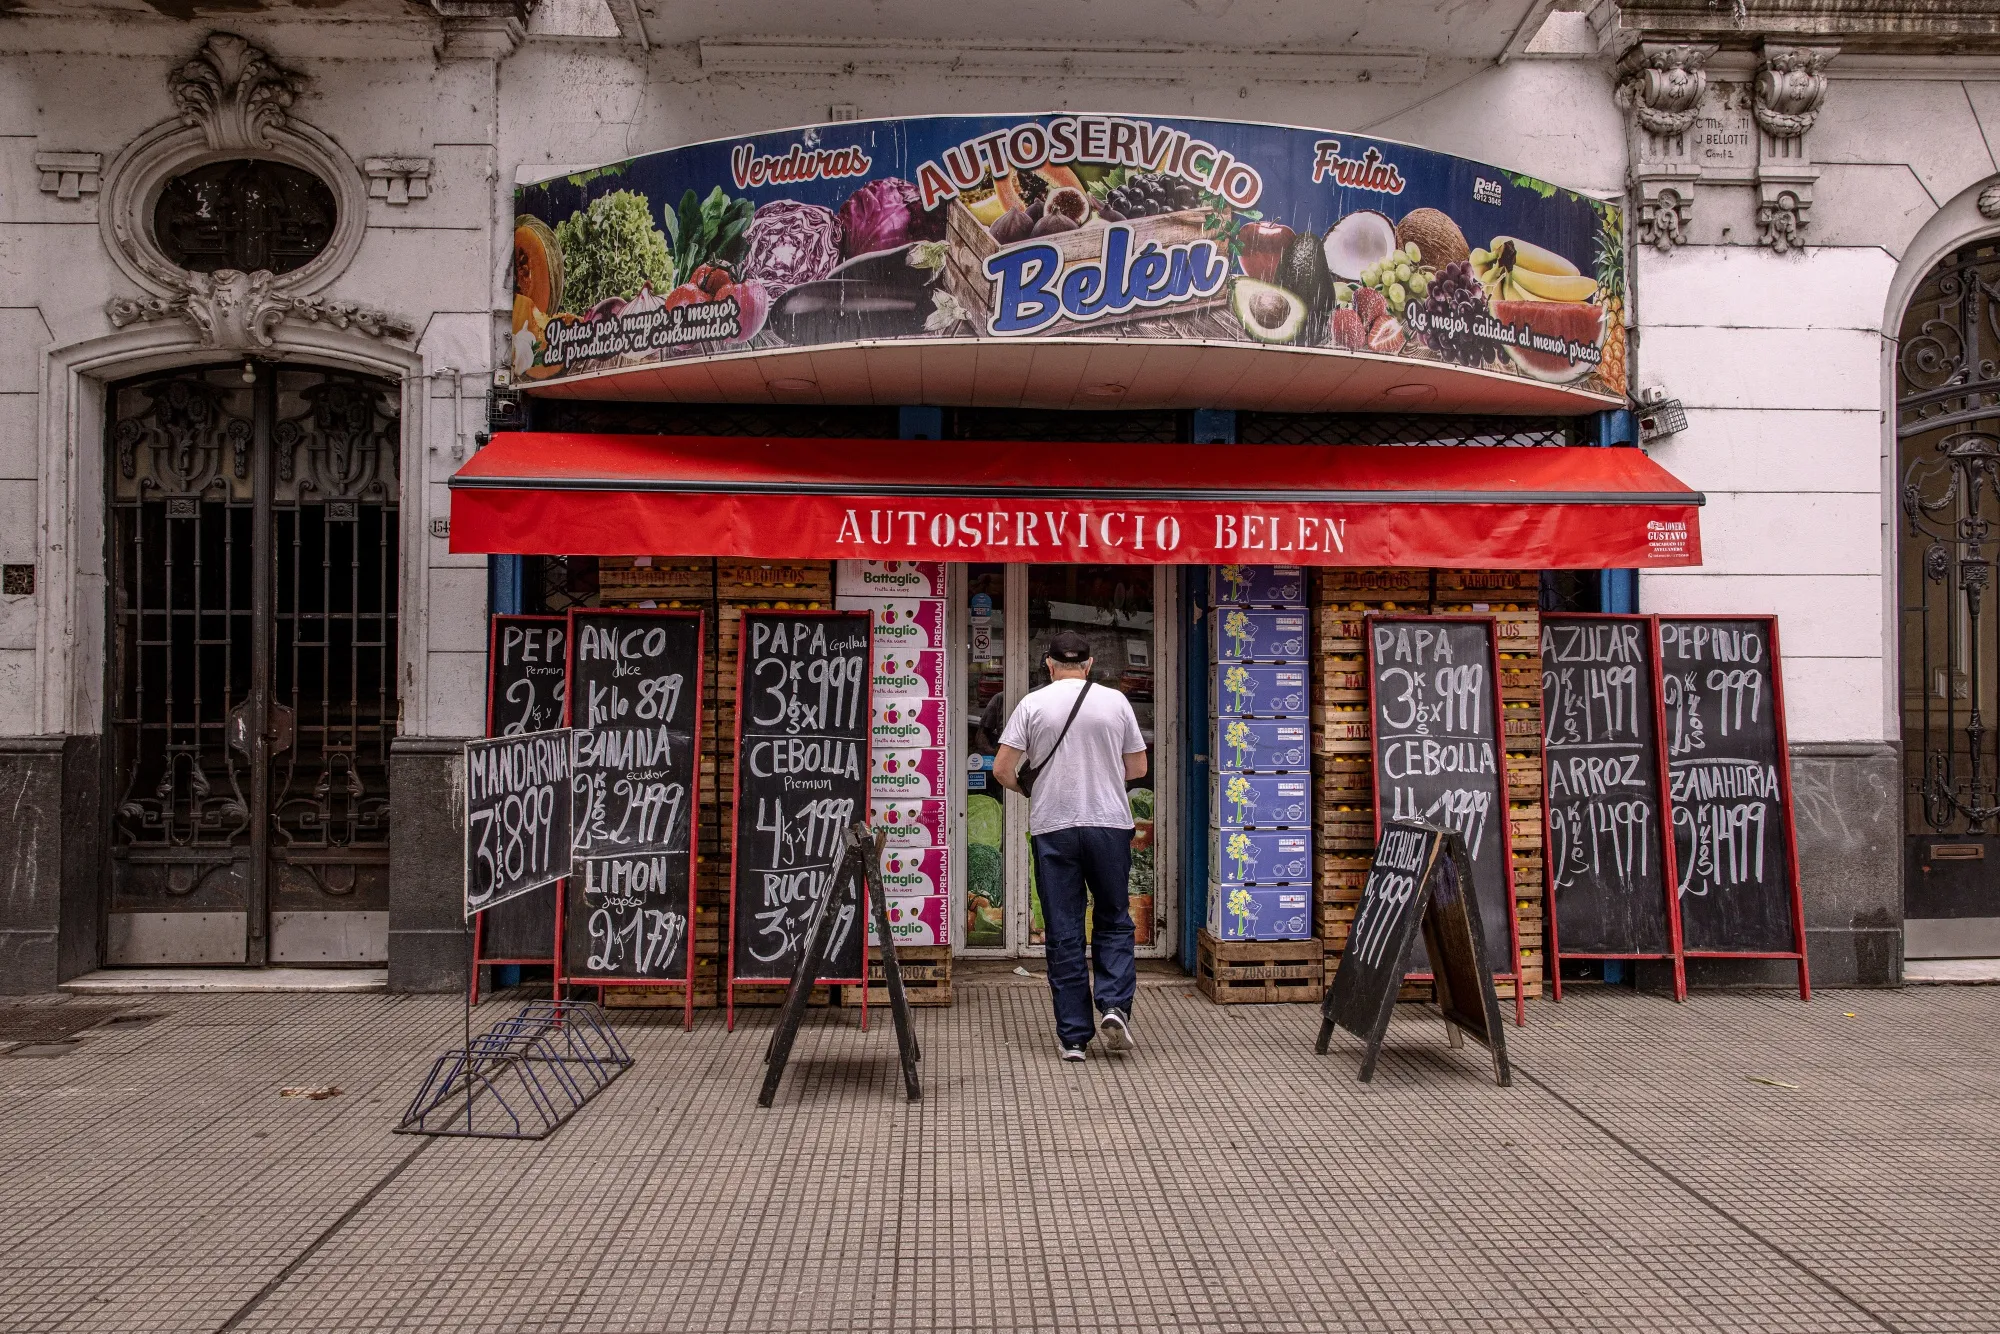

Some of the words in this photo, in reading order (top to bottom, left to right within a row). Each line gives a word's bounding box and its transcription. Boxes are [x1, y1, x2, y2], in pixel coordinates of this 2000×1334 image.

[1696, 134, 1703, 145] J
[1706, 132, 1748, 145] BELLOTTI
[732, 144, 870, 188] Verduras
[918, 117, 1261, 210] AUTOSERVICIO
[1312, 141, 1406, 194] Frutas
[1474, 177, 1502, 195] Rafa
[987, 227, 1228, 335] Belén
[544, 342, 563, 364] del
[566, 336, 630, 367] productor
[634, 329, 649, 348] al
[653, 318, 739, 346] consumidor
[547, 320, 592, 346] Ventas
[596, 321, 619, 343] por
[623, 312, 669, 337] mayor
[673, 309, 683, 331] y
[688, 299, 738, 321] menor
[1407, 301, 1428, 332] La
[1432, 313, 1469, 341] mejor
[1473, 318, 1516, 344] calidad
[1519, 328, 1531, 346] al
[1533, 335, 1568, 355] menor
[1569, 343, 1600, 365] precio
[836, 508, 1181, 552] AUTOSERVICIO
[1214, 513, 1347, 554] BELEN
[1647, 531, 1688, 541] GUSTAVO
[864, 571, 921, 587] Battaglio
[503, 626, 567, 666] PEP
[579, 625, 666, 661] ANCO
[753, 622, 828, 659] PAPA
[934, 602, 943, 647] PREMIUM
[1374, 627, 1453, 666] PAPA
[1541, 625, 1643, 663] AZUCAR
[1660, 624, 1763, 664] PEPINO
[612, 660, 642, 678] dulce
[934, 652, 943, 696] PREMIUM
[504, 678, 536, 736] 2
[634, 673, 684, 723] 899
[753, 657, 788, 726] 3
[807, 656, 863, 731] 999
[1380, 667, 1416, 729] 3
[1434, 663, 1483, 734] 999
[1542, 670, 1567, 746] 2
[1583, 665, 1639, 742] 1499
[1664, 674, 1692, 757] 2
[1706, 669, 1763, 737] 999
[937, 701, 945, 745] PREMIUM
[470, 737, 571, 800] MANDARINA
[571, 724, 672, 771] BANANA
[749, 738, 860, 781] CEBOLLA
[1384, 739, 1497, 779] CEBOLLA
[937, 751, 945, 795] PREMIUM
[1550, 754, 1647, 799] ARROZ
[571, 773, 593, 850] 2
[610, 779, 685, 845] 2499
[756, 797, 781, 869] 4
[937, 801, 945, 845] PREMIUM
[468, 808, 495, 905] 3
[503, 784, 555, 881] 899
[1375, 828, 1429, 877] LECHUGA
[1550, 807, 1575, 891] 2
[1589, 800, 1650, 877] 1499
[1672, 806, 1708, 900] 2
[1712, 801, 1766, 886] 1499
[585, 857, 667, 897] LIMON
[602, 896, 644, 914] jugoso
[1360, 871, 1413, 970] 999
[586, 908, 620, 971] 2
[748, 906, 788, 962] 3
